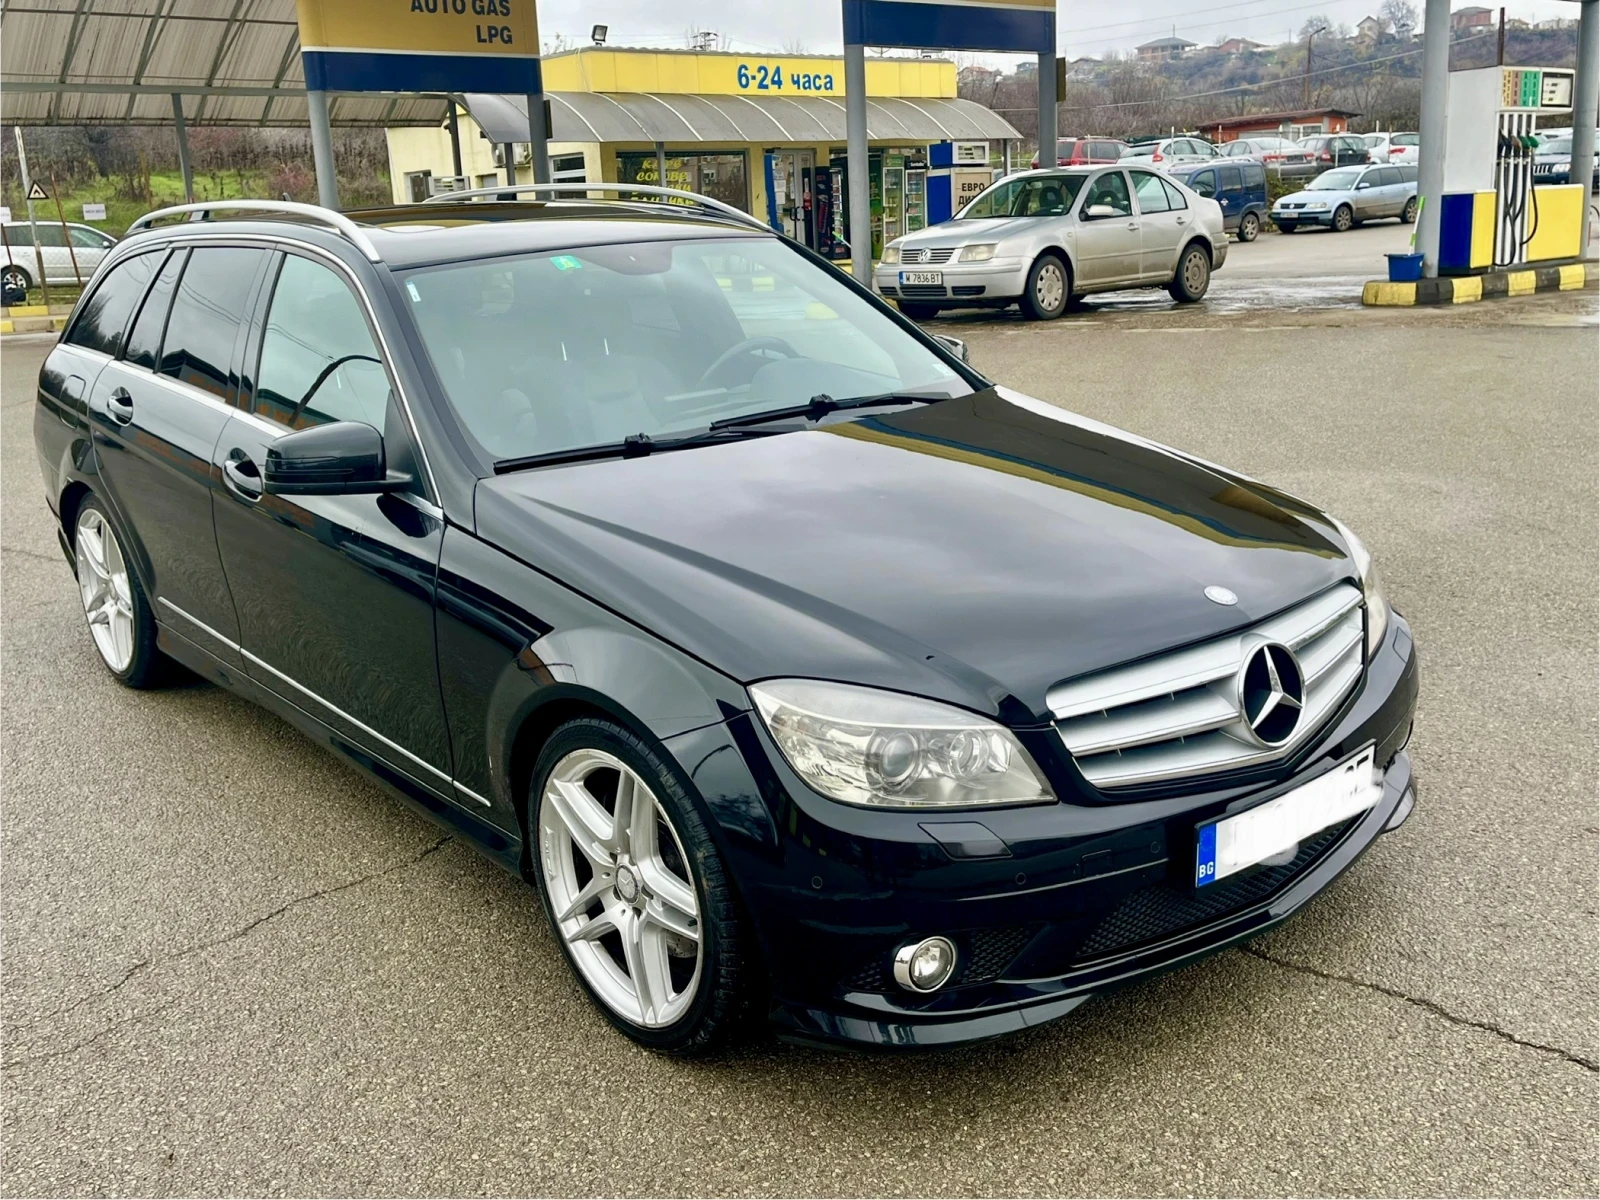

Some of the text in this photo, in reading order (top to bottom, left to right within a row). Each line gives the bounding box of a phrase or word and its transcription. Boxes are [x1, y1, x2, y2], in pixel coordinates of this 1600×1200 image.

[411, 0, 511, 17] AUTO GAS
[476, 24, 513, 44] LPG
[737, 64, 833, 91] 6-24 часа
[961, 183, 985, 191] ЕВРО
[913, 273, 930, 284] 7836
[1199, 861, 1214, 879] BG
